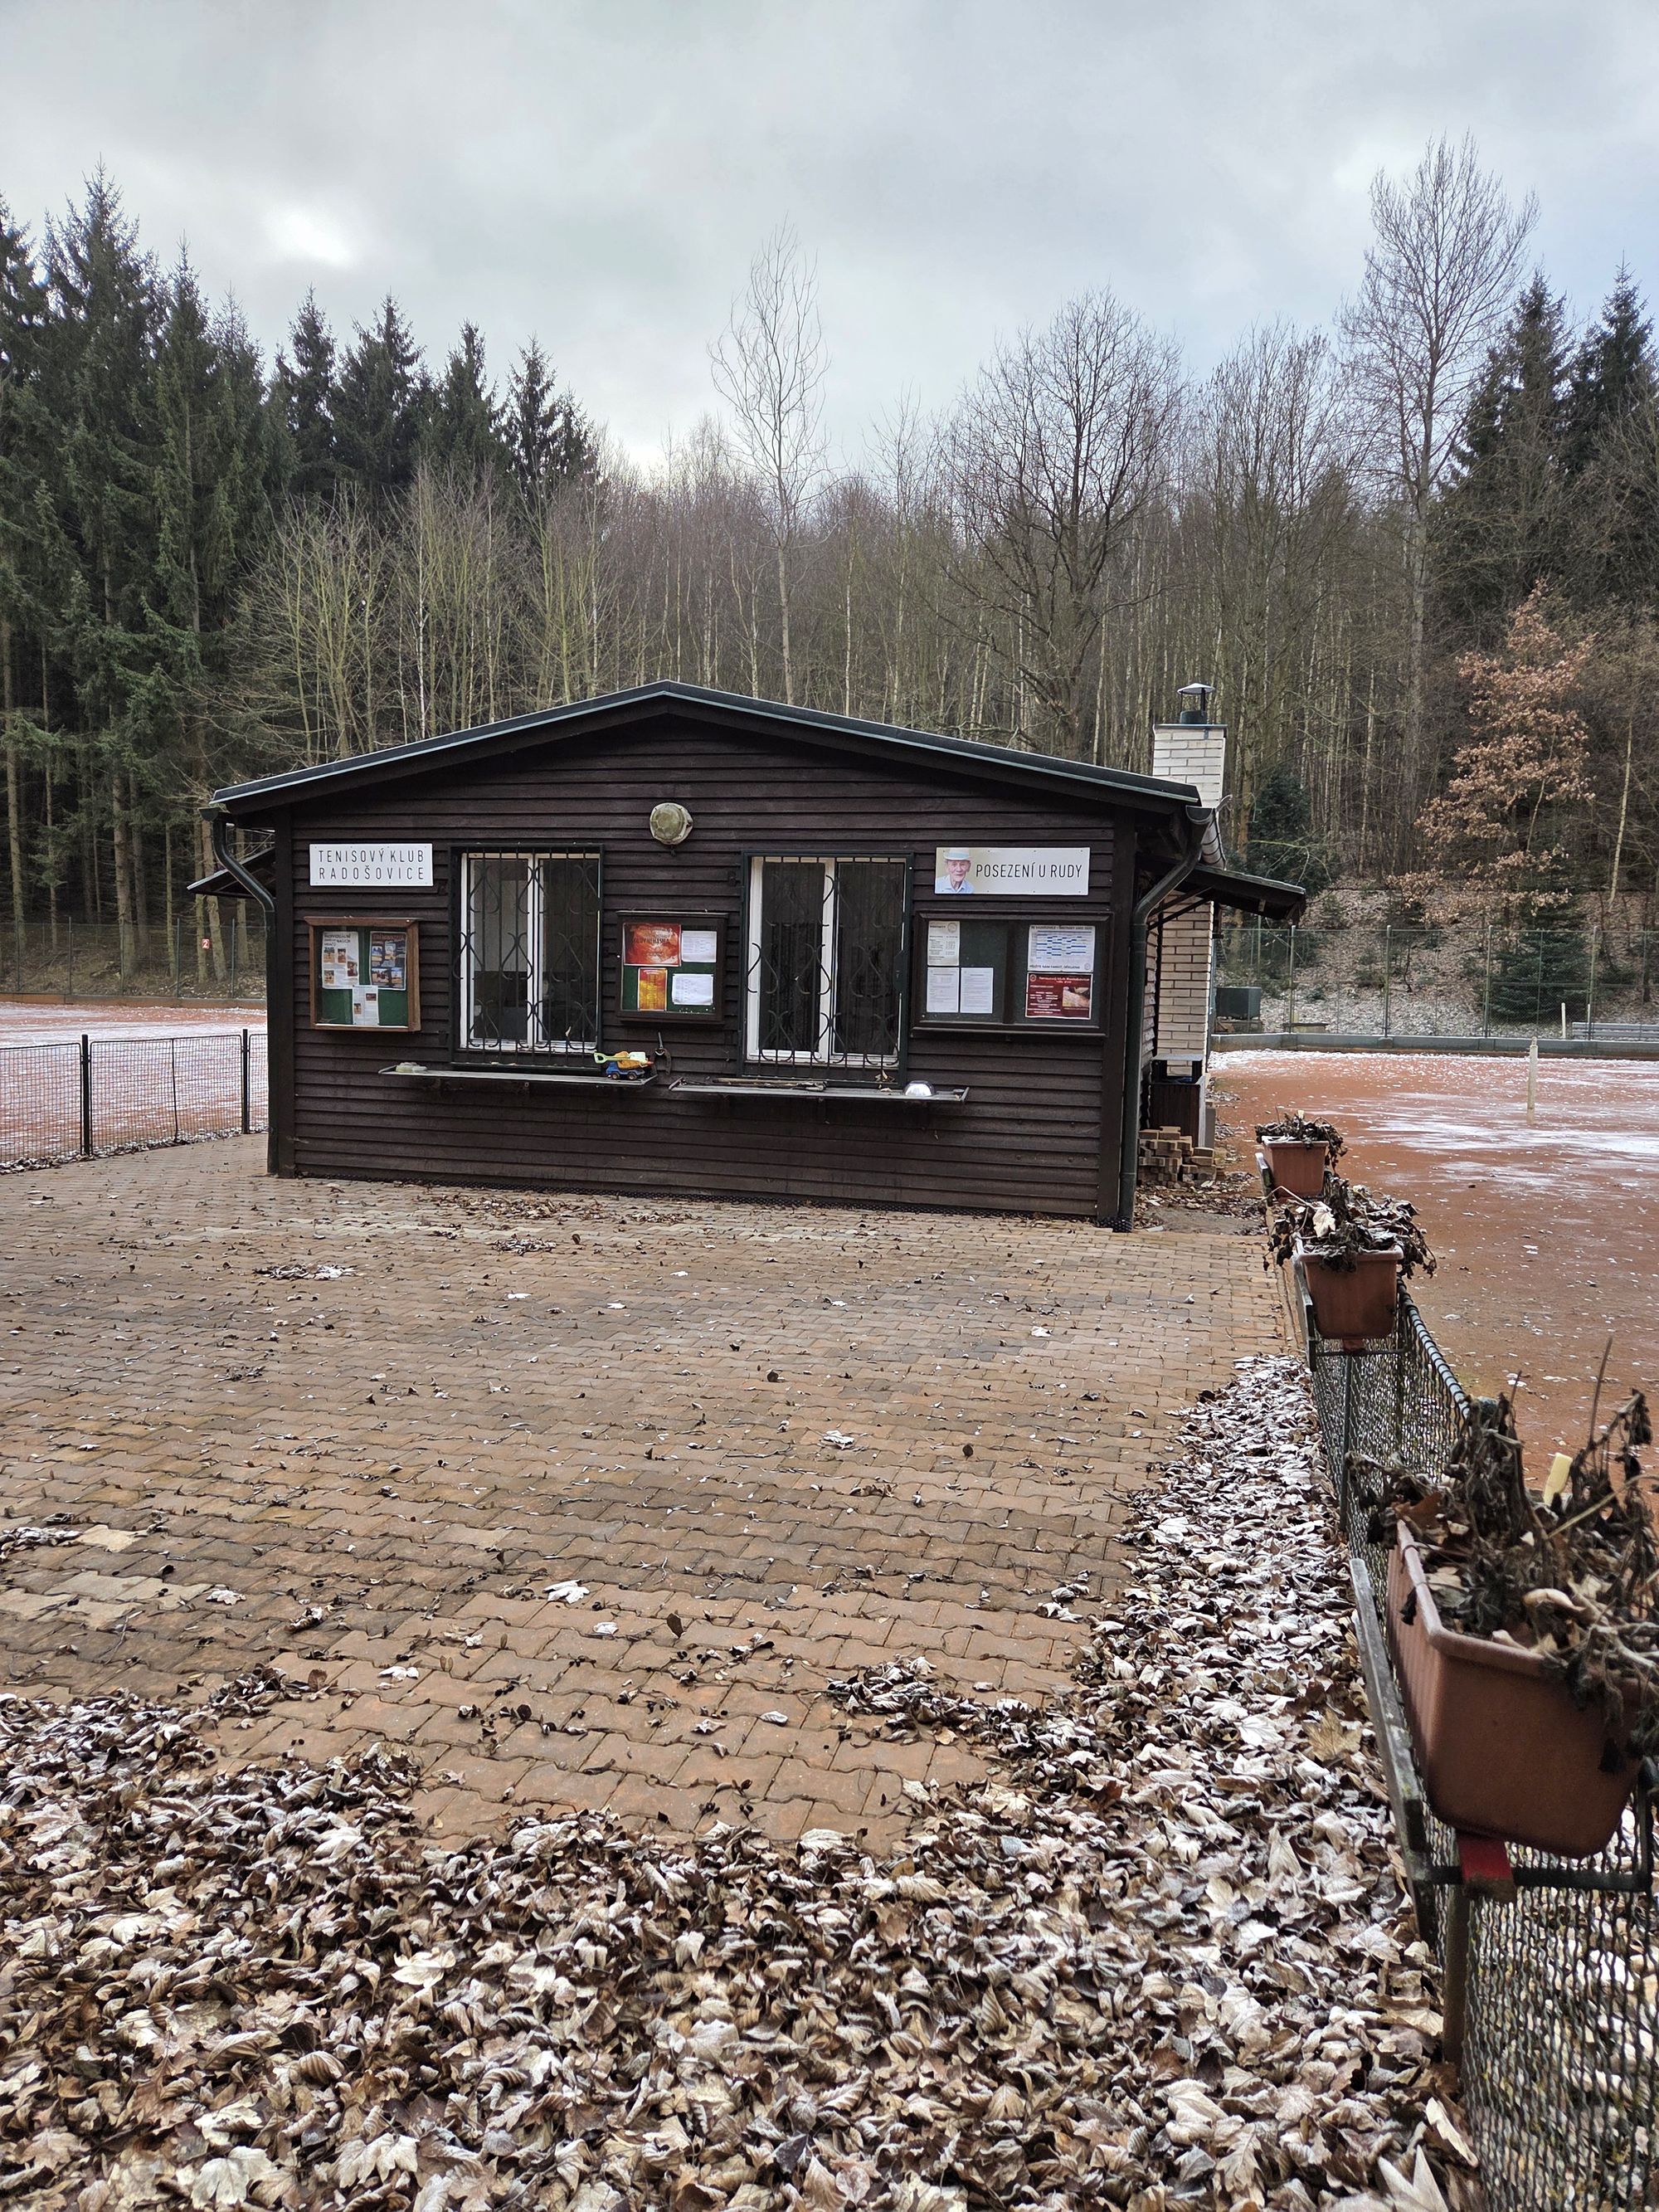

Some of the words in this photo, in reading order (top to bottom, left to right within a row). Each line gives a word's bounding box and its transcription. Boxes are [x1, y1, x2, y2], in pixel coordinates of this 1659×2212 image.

[319, 848, 384, 863] TENISOVÝ
[390, 850, 424, 863] KLUB
[319, 865, 424, 879] RADOŠOVICE
[975, 862, 1036, 878] POSEZENÍ
[1039, 865, 1046, 878] U
[1050, 865, 1082, 878] RUDY
